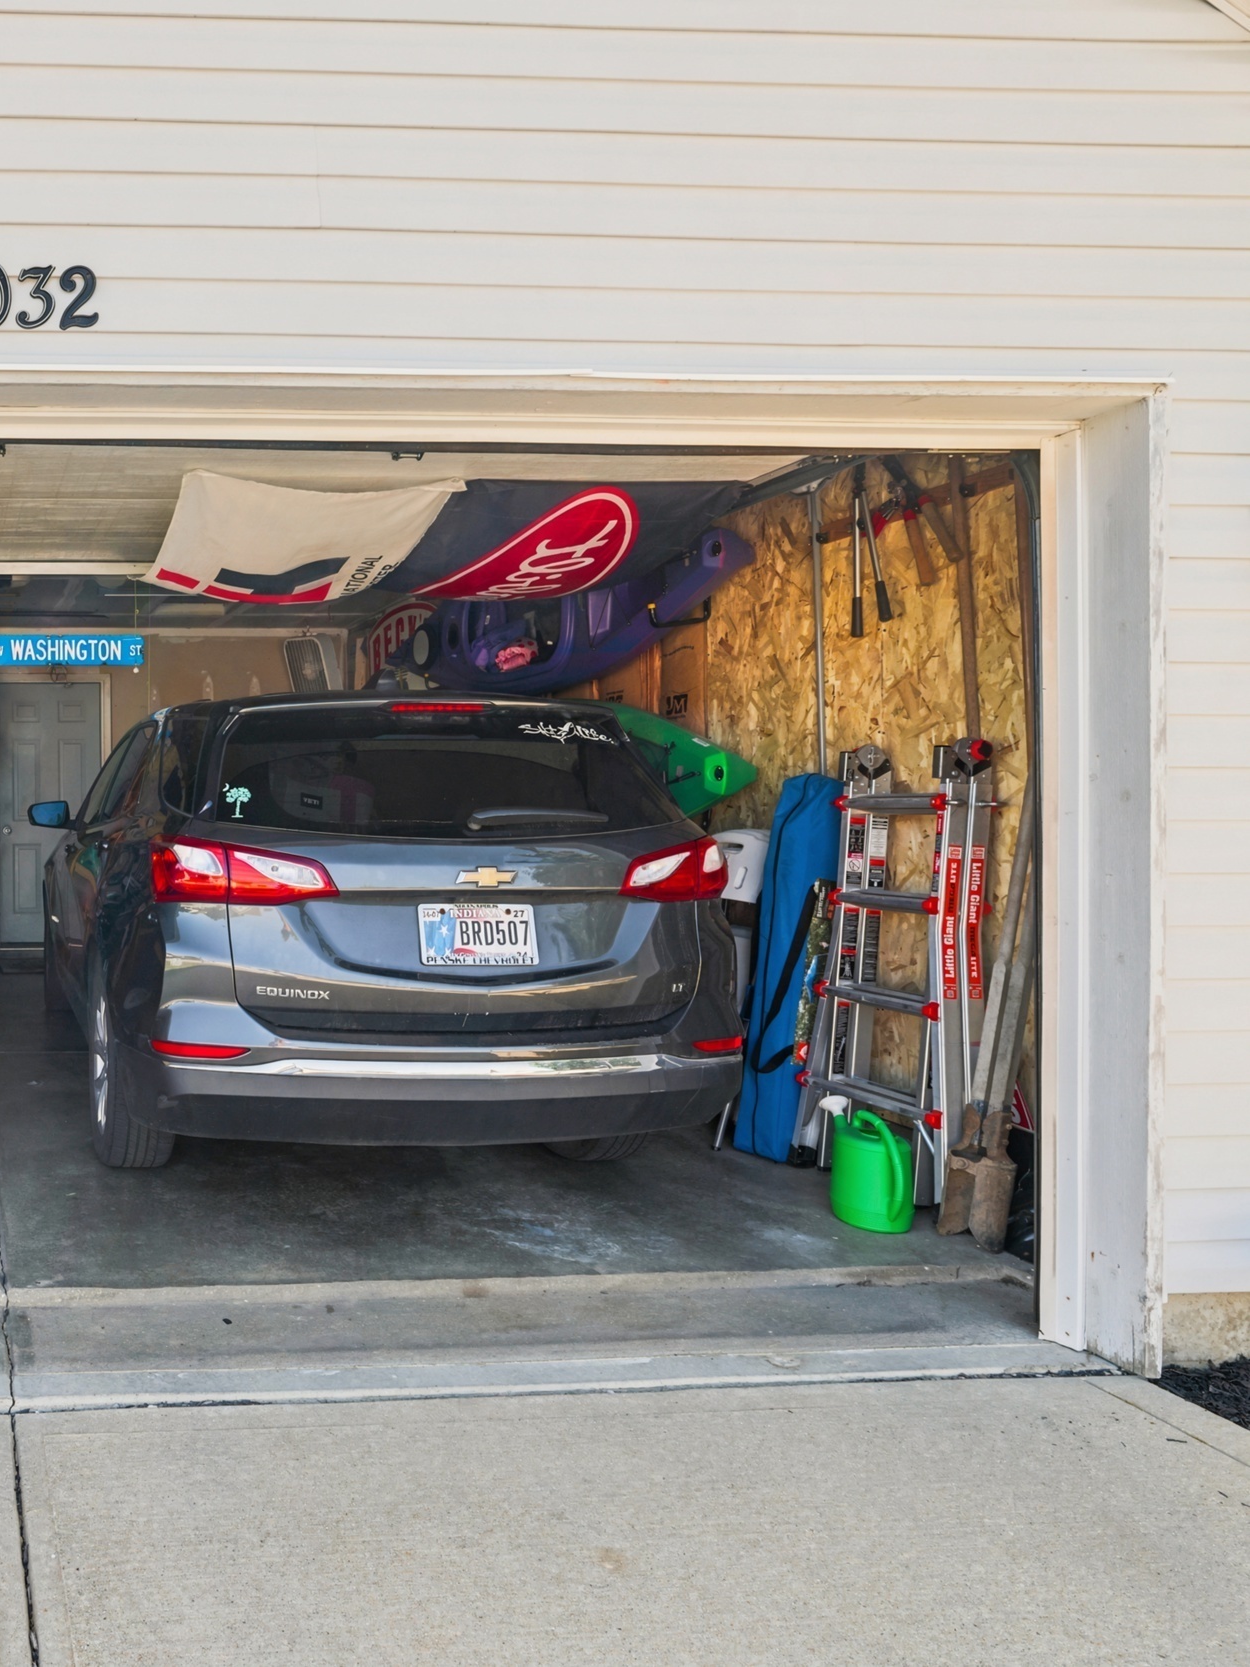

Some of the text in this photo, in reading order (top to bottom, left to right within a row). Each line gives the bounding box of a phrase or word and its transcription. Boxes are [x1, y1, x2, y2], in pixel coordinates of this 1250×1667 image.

[11, 639, 121, 661] WASHINGTON
[129, 645, 141, 656] ST
[666, 693, 688, 715] JM
[302, 796, 319, 805] YETI
[970, 862, 982, 891] Little
[451, 909, 502, 918] INDIANA
[513, 910, 525, 918] 27
[968, 894, 980, 923] Giant
[459, 921, 529, 946] BRD507
[944, 916, 955, 944] Giant
[945, 949, 955, 978] Little
[256, 986, 330, 1000] EQUINOX
[672, 983, 686, 992] LT
